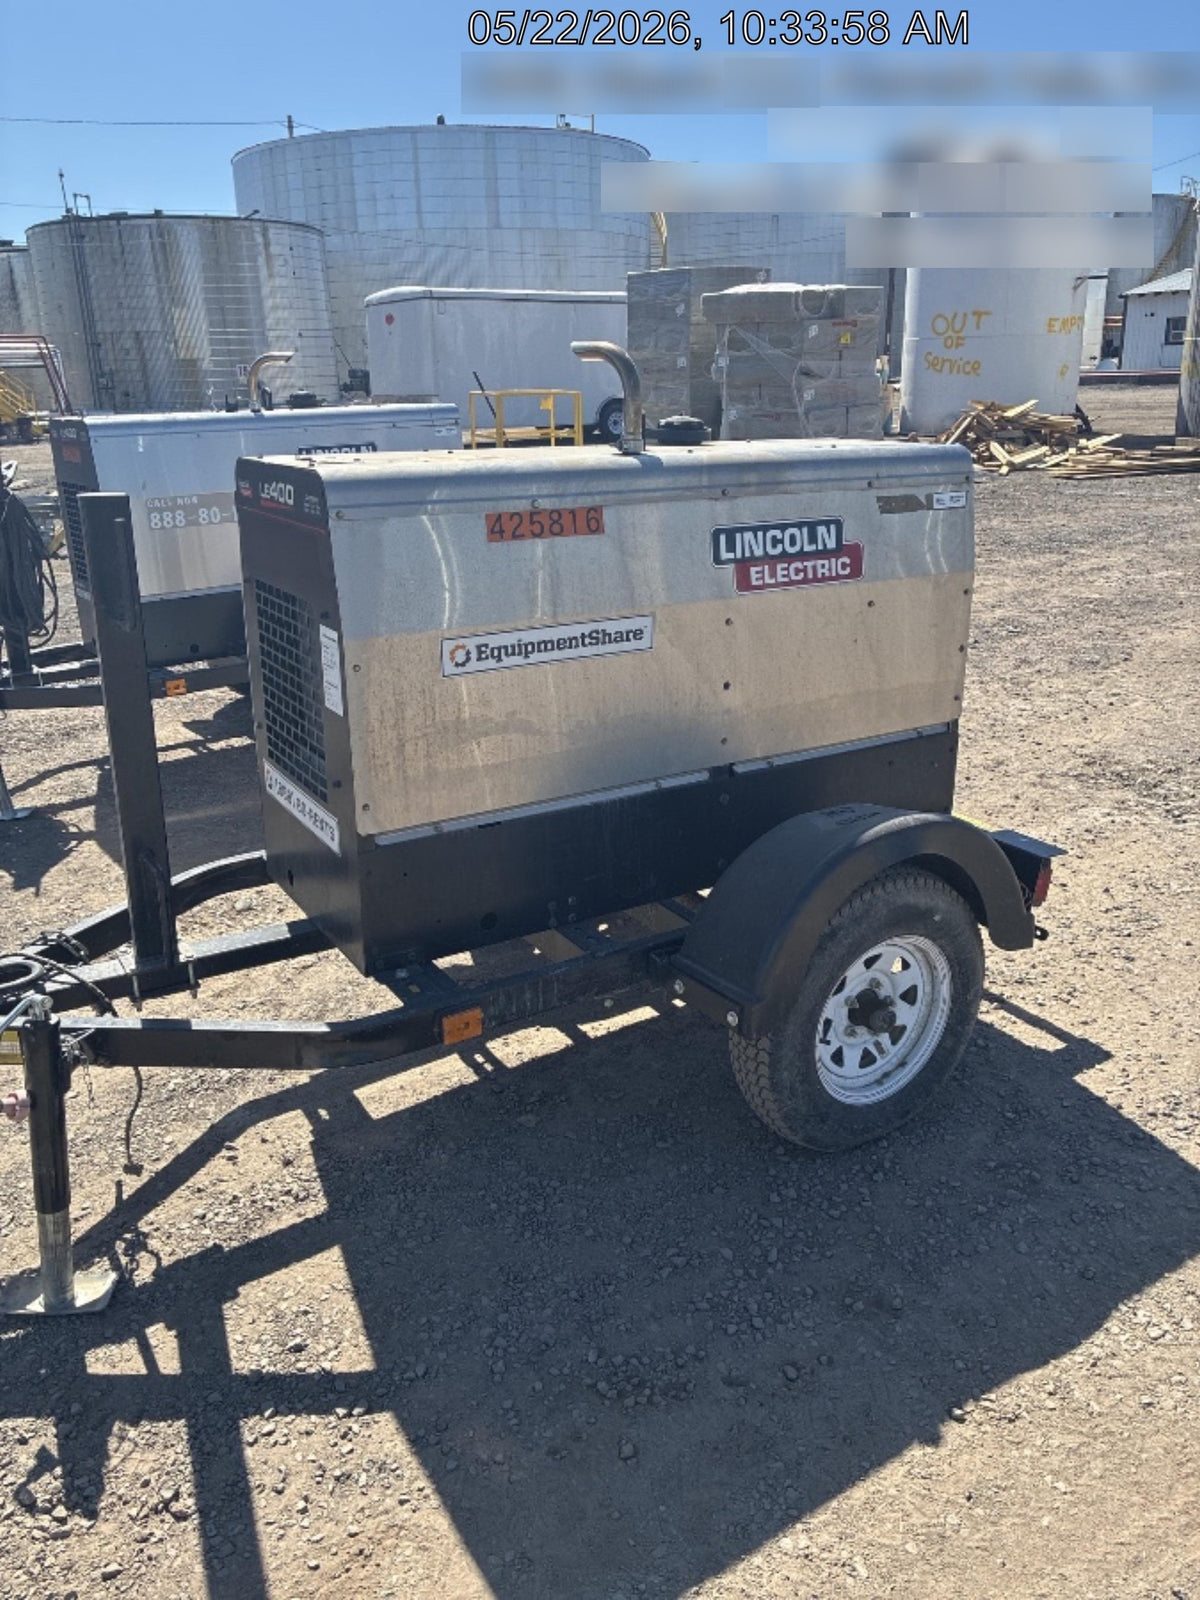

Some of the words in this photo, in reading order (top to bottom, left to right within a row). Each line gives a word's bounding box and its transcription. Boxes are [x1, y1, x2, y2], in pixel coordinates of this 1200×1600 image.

[931, 310, 992, 336] OUT
[943, 335, 966, 350] OF
[489, 507, 602, 540] 425816
[719, 523, 838, 561] LINCOLN
[749, 556, 852, 587] ELECTRIC
[475, 626, 647, 663] EquipmentShare
